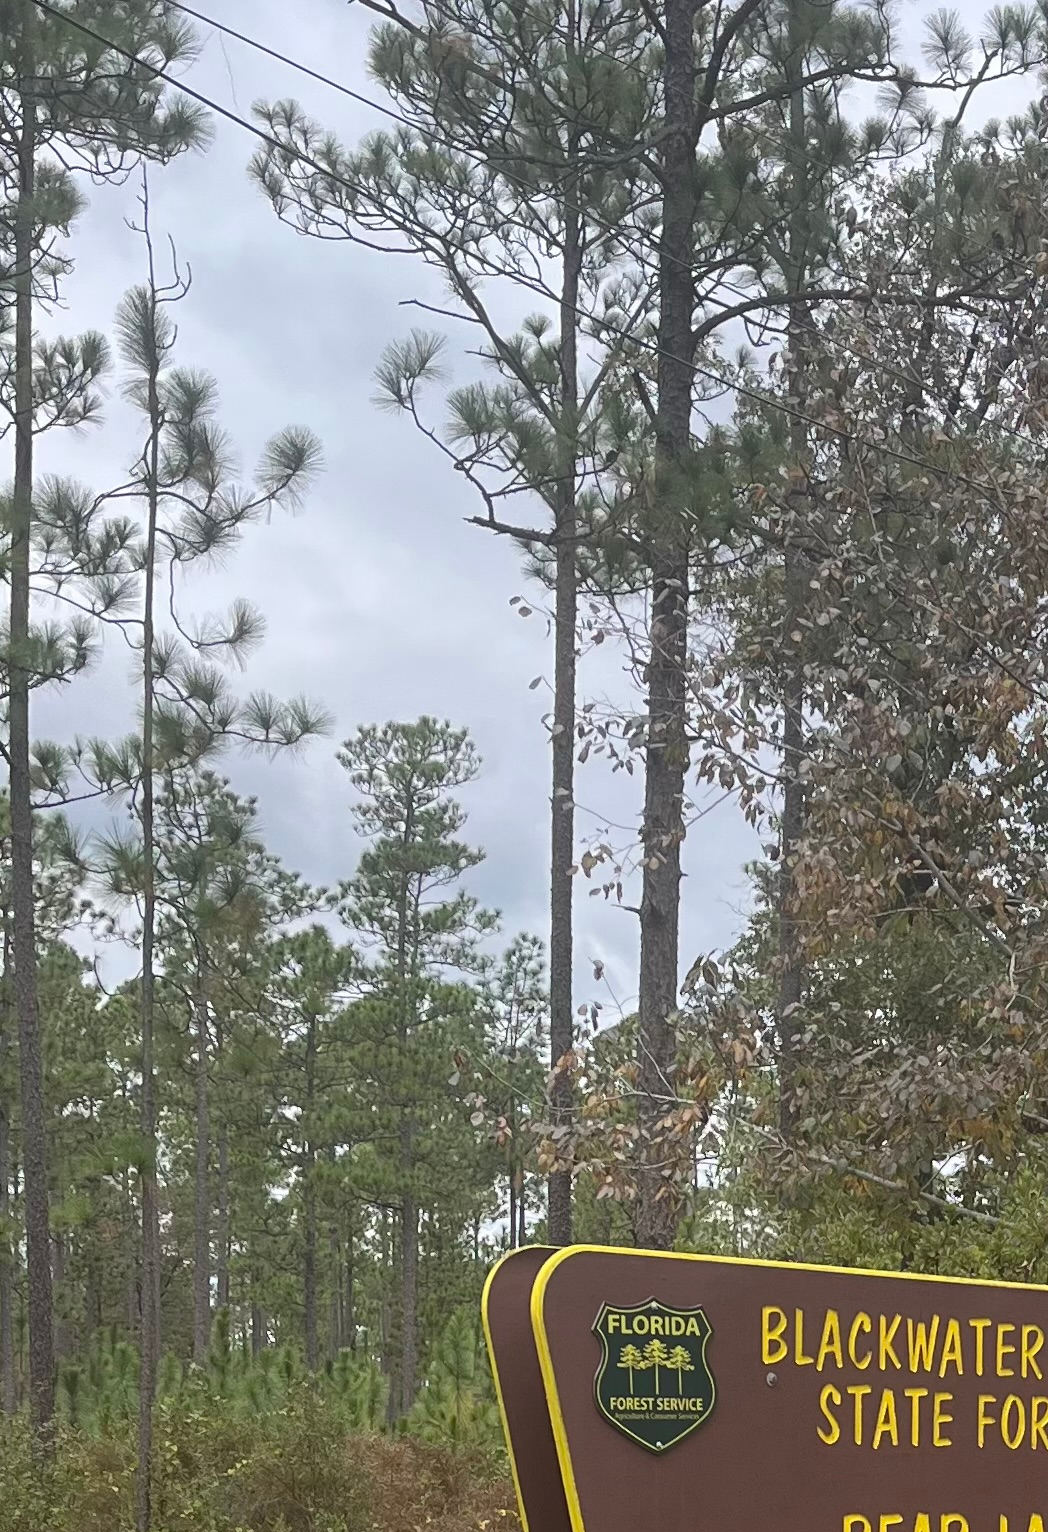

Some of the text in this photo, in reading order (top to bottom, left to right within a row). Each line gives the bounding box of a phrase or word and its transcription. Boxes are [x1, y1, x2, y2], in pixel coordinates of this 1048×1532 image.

[607, 1315, 701, 1336] FLORIDA
[761, 1306, 1045, 1380] BLACKWATER
[609, 1397, 703, 1411] FOREST SERVICE
[816, 1383, 954, 1450] STATE
